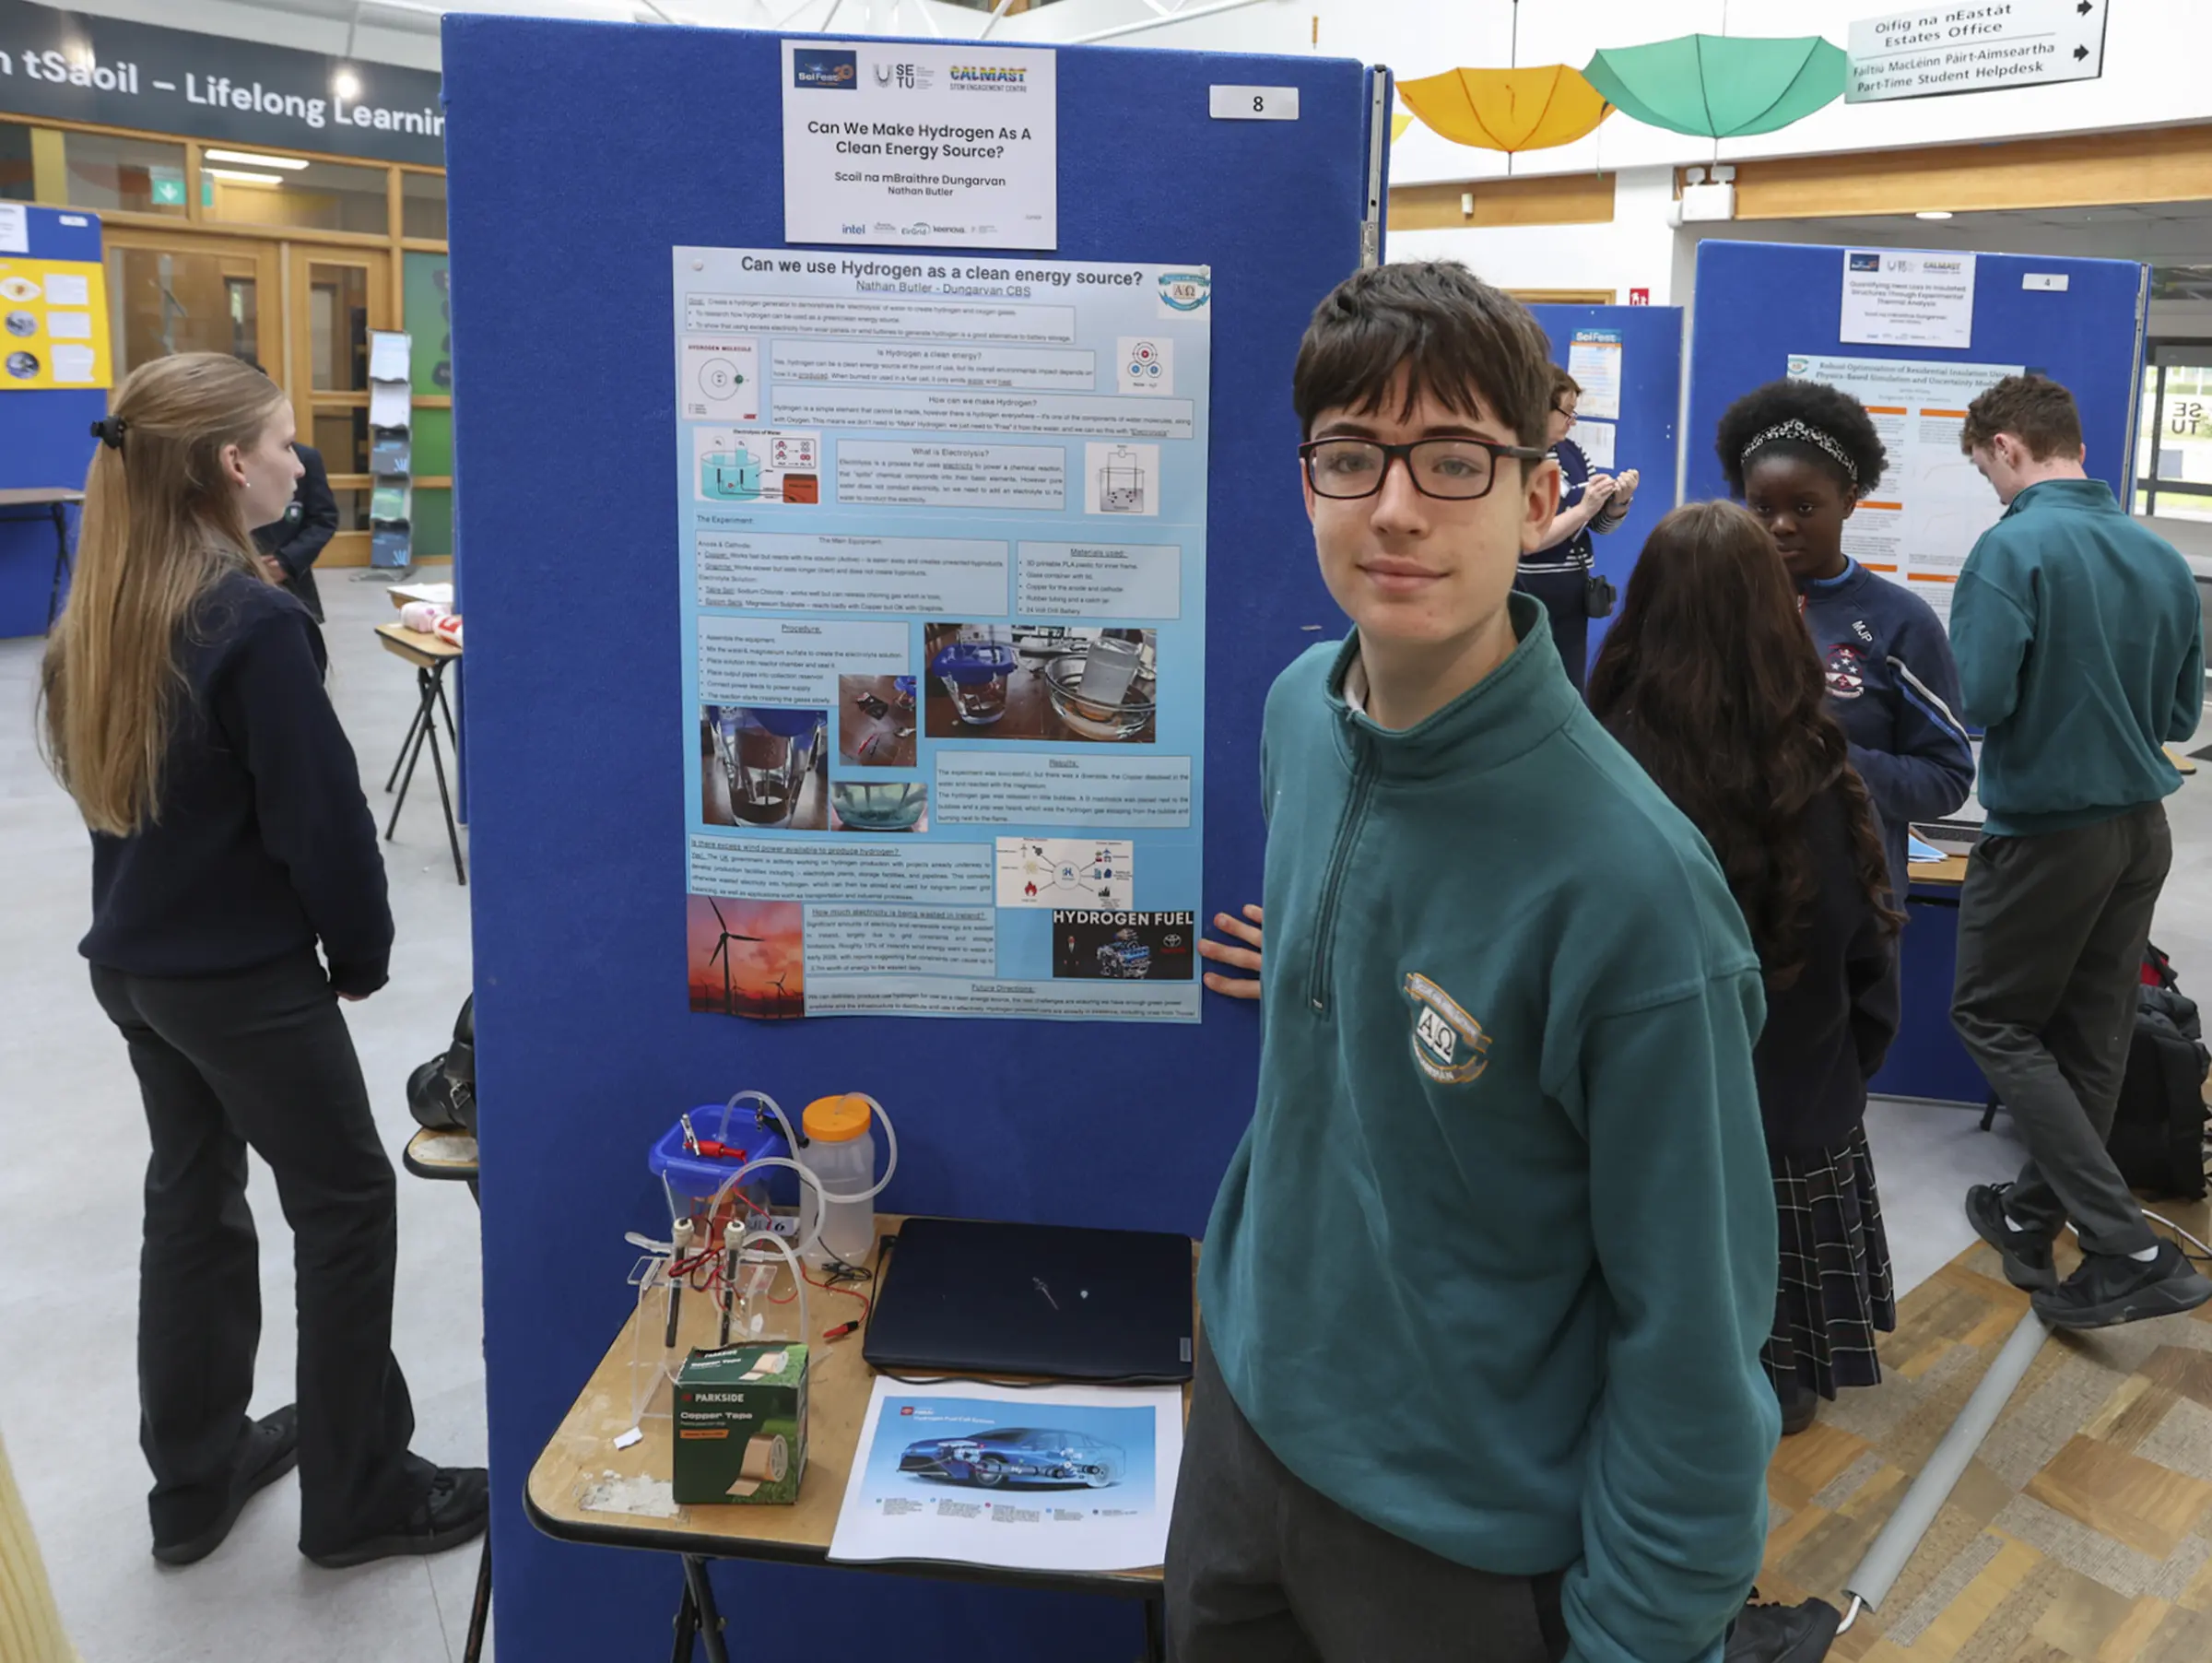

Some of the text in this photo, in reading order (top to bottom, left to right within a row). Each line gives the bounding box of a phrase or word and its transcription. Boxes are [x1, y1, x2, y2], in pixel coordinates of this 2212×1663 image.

[1875, 19, 1912, 33] Oifig
[1919, 17, 1937, 26] na
[1885, 23, 2002, 47] Estates Office
[948, 65, 1027, 82] CALMAST
[1918, 69, 1969, 84] Student
[1976, 61, 2043, 78] Helpdesk
[22, 49, 138, 94] tSaoil
[185, 72, 326, 128] Lifelong
[1253, 96, 1264, 112] 8
[807, 121, 1031, 141] Can We Make Hydrogen As A
[836, 140, 1005, 159] Clean Energy Source?
[834, 171, 1006, 188] Scoil na mBraithre Dungarvan
[888, 186, 954, 196] Nathan Butler
[841, 224, 865, 235] intel
[741, 255, 1142, 286] Can we use Hydrogen as a clean energy source?
[856, 280, 895, 292] Nathan
[899, 281, 932, 293] Butler
[943, 283, 1002, 297] Dungarvan
[1006, 285, 1030, 297] CBS
[885, 349, 922, 359] Hydrogen
[951, 351, 982, 360] energy?
[996, 398, 1036, 407] Hydrogen?
[941, 448, 989, 457] Electrolysis?
[1852, 620, 1873, 643] MJP
[1053, 910, 1193, 926] HYDROGEN FUEL
[695, 1393, 745, 1403] PARKSIDE
[680, 1411, 753, 1421] Copper Tape
